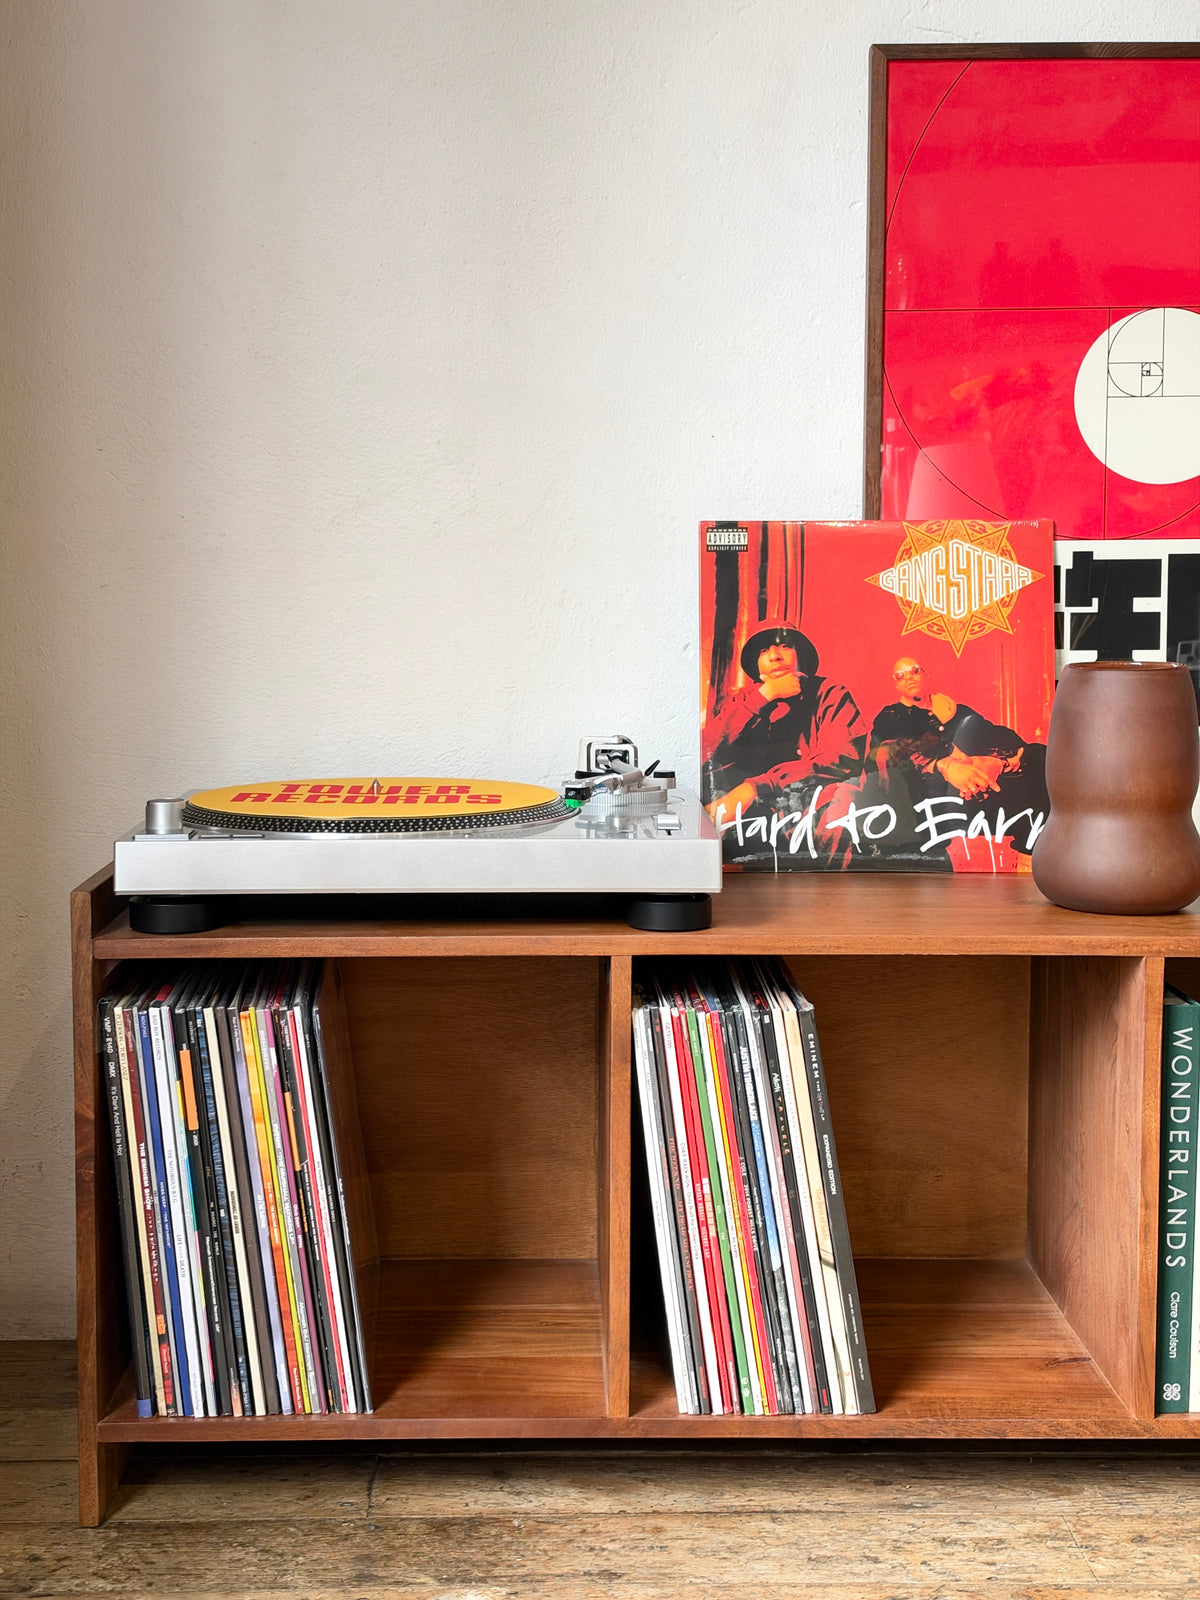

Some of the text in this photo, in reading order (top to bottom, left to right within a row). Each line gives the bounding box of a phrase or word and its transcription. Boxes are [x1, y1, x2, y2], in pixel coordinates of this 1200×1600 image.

[708, 533, 747, 544] ADVISORY
[230, 792, 502, 805] RECORDS
[280, 784, 471, 795] TOWER
[716, 785, 819, 859] Hard
[826, 801, 896, 853] to
[807, 1033, 819, 1078] EMINEM
[112, 1094, 120, 1110] Dark
[739, 1046, 758, 1121] JUSTIN TIMBERLAKE
[822, 1134, 836, 1195] EXPANDED EDITION
[1166, 1026, 1192, 1268] WONDERLANDS
[141, 1158, 149, 1187] EMINEM
[144, 1188, 152, 1210] SHOW
[1168, 1290, 1180, 1358] Clare Coulson
